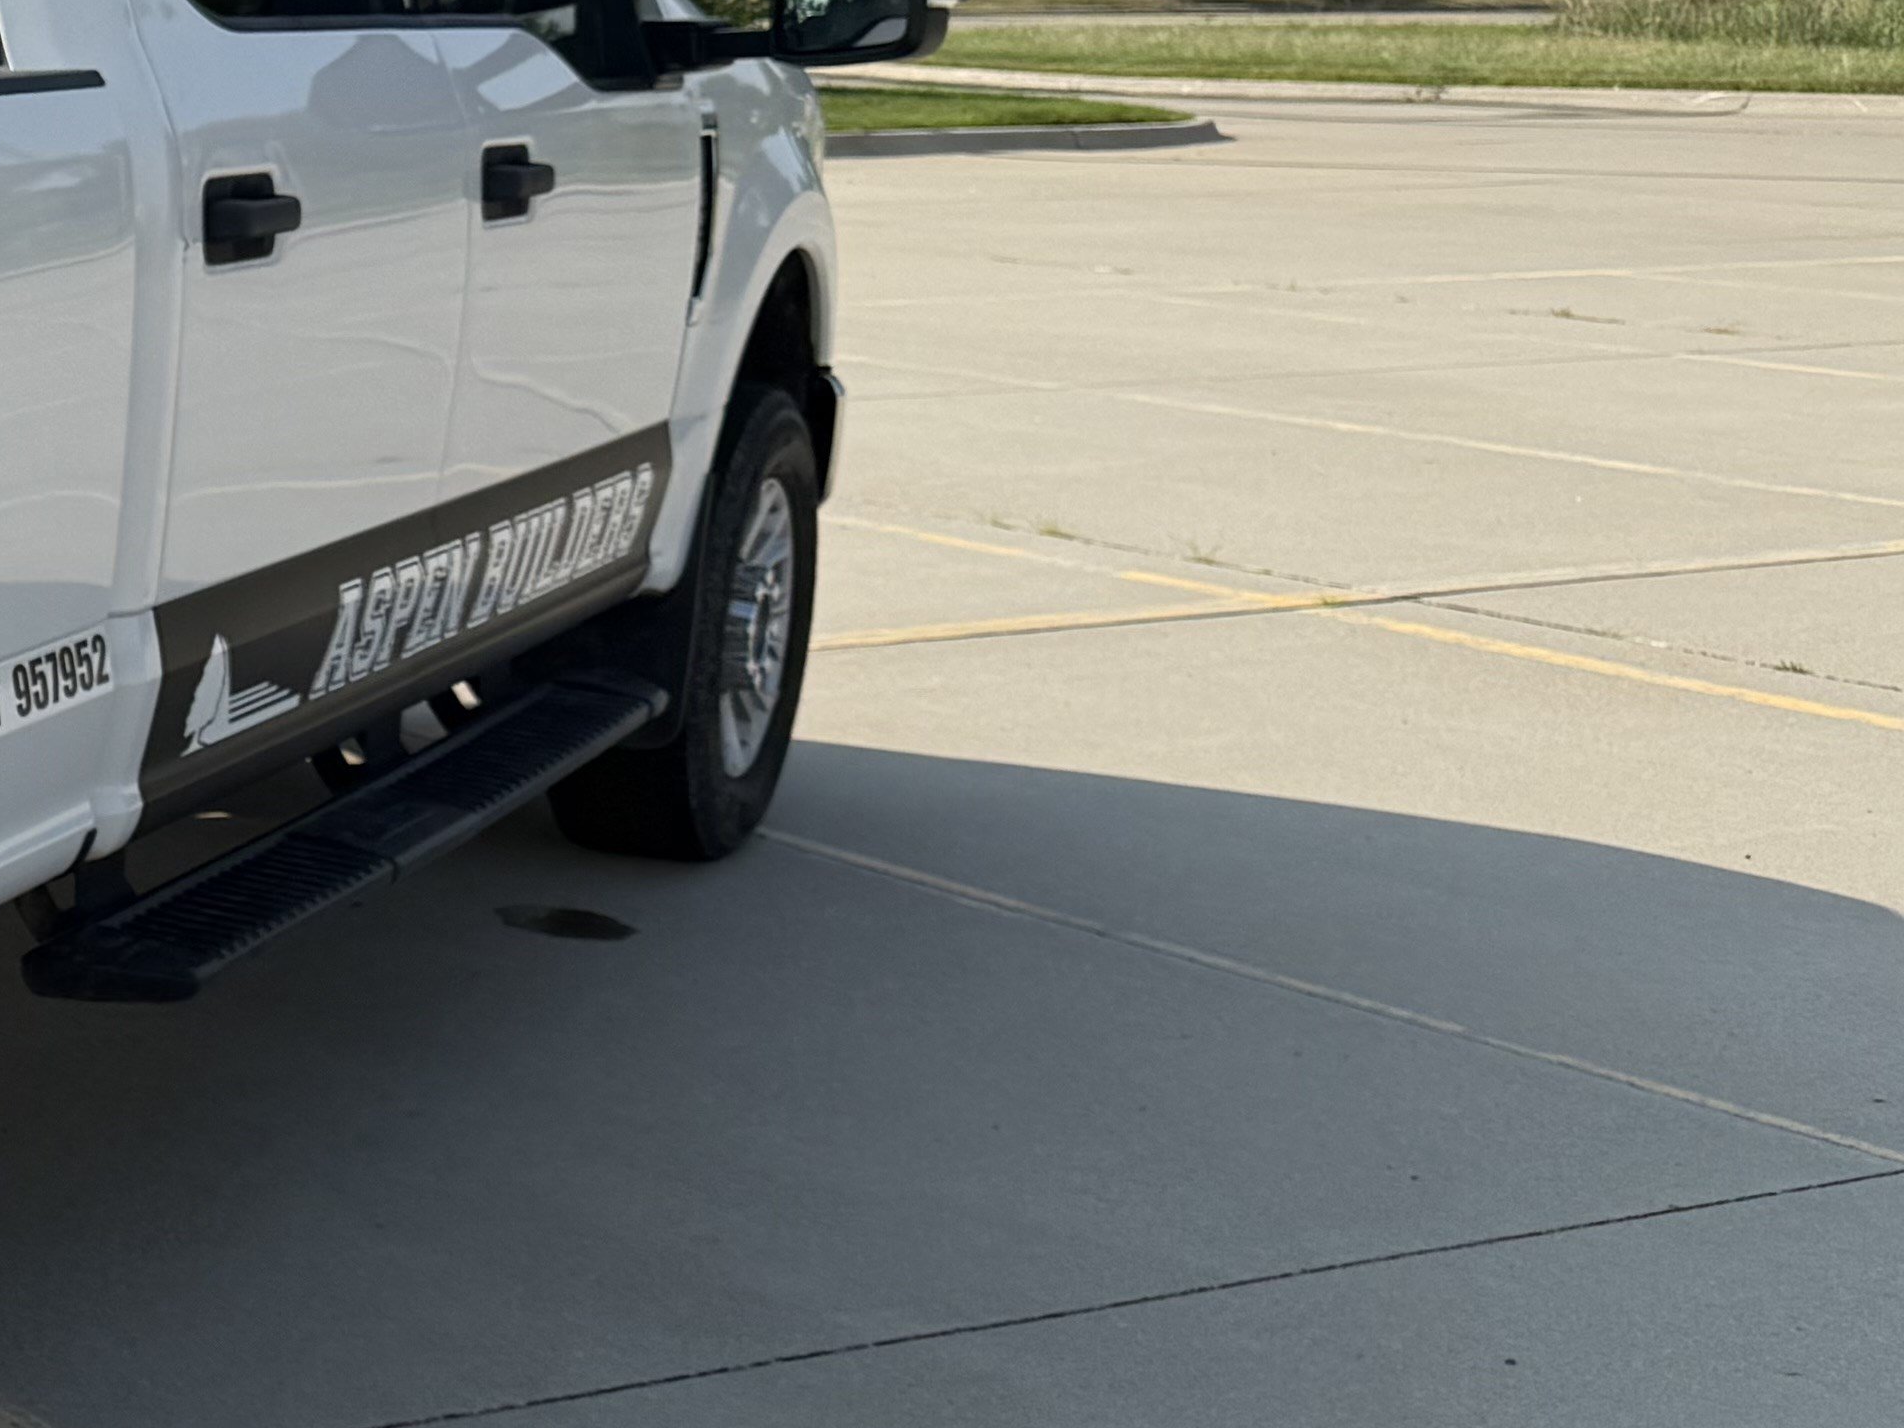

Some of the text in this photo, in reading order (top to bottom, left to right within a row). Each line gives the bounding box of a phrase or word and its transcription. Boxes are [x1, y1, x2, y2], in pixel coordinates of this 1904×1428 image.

[308, 461, 655, 701] ASPEN BUILDERS
[11, 633, 111, 718] 957952
